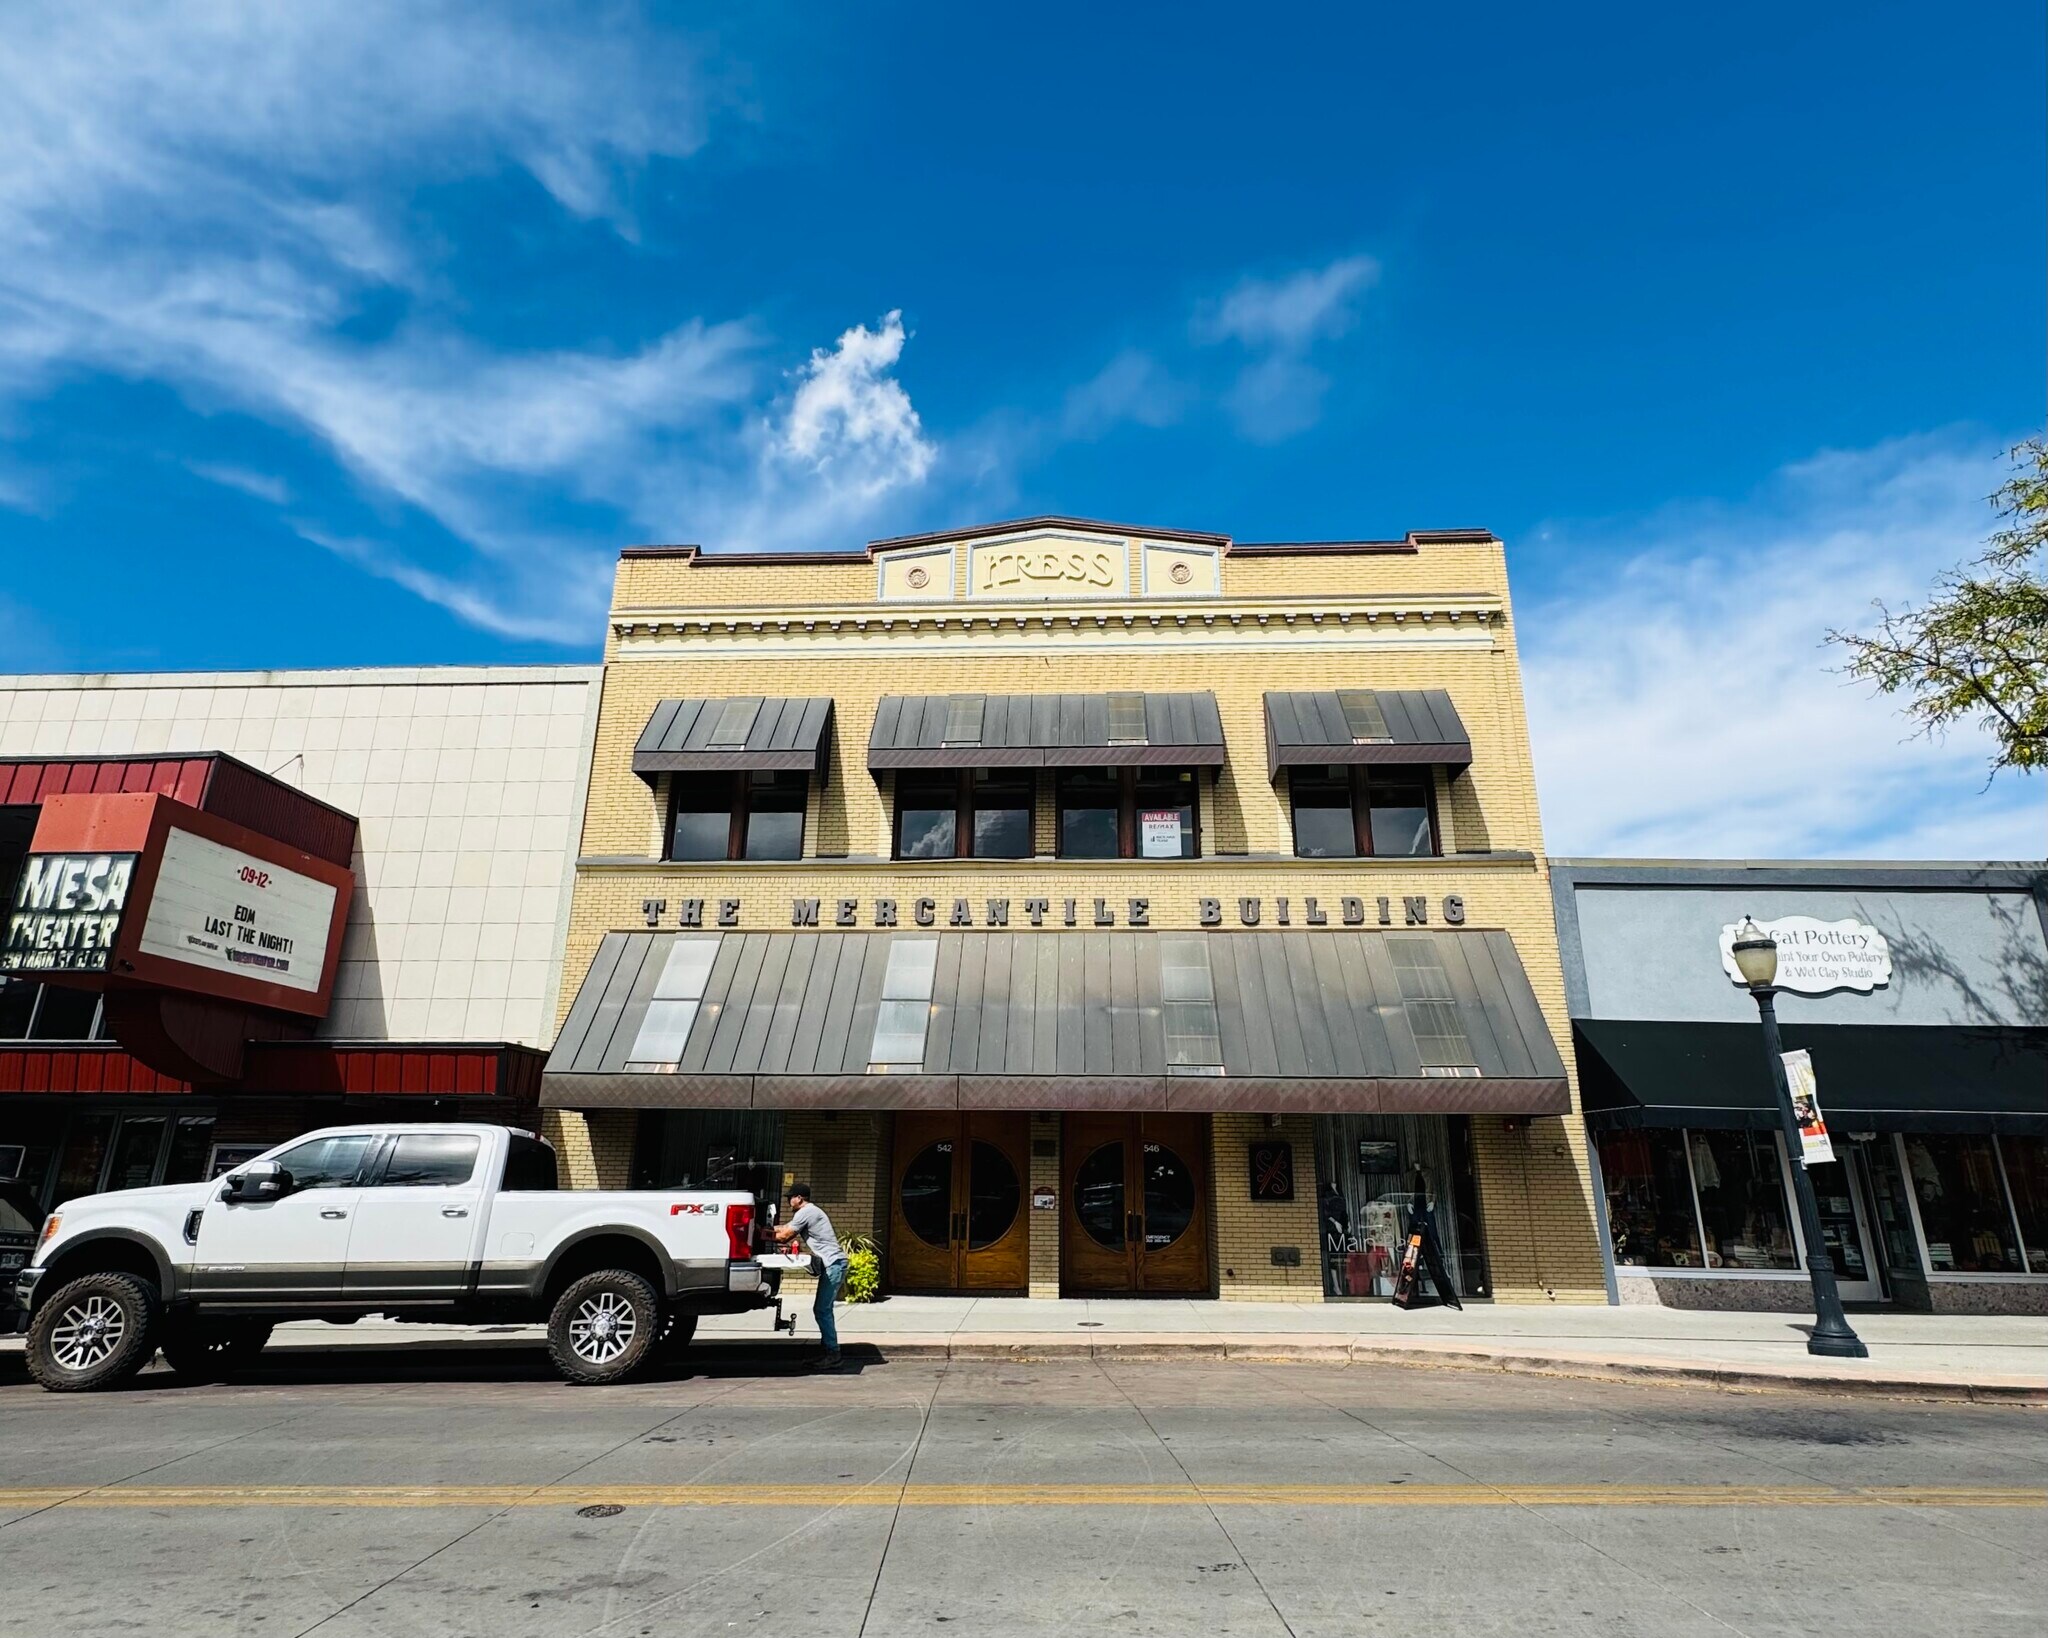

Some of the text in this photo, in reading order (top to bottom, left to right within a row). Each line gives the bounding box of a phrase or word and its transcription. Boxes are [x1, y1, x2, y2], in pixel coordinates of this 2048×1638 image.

[983, 553, 1114, 590] KRESS
[1144, 812, 1179, 821] AVAILABLE
[19, 857, 133, 911] MESA
[234, 904, 256, 925] EDM
[642, 895, 1465, 927] THE MERCANTILE BUILDING
[9, 913, 120, 949] THEATER
[204, 916, 233, 938] LAST
[237, 925, 256, 944] THE
[258, 931, 294, 954] NIGHT!
[1769, 930, 1801, 945] Cat
[1805, 930, 1870, 949] Pottery
[23, 951, 57, 969] MAIN
[1777, 951, 1884, 965] int Your Own Pottery
[1785, 967, 1874, 980] & Wet Clay Studio
[936, 1144, 953, 1152] 542
[1143, 1144, 1160, 1153] 546
[670, 1203, 720, 1216] FX4
[1327, 1232, 1377, 1254] Main
